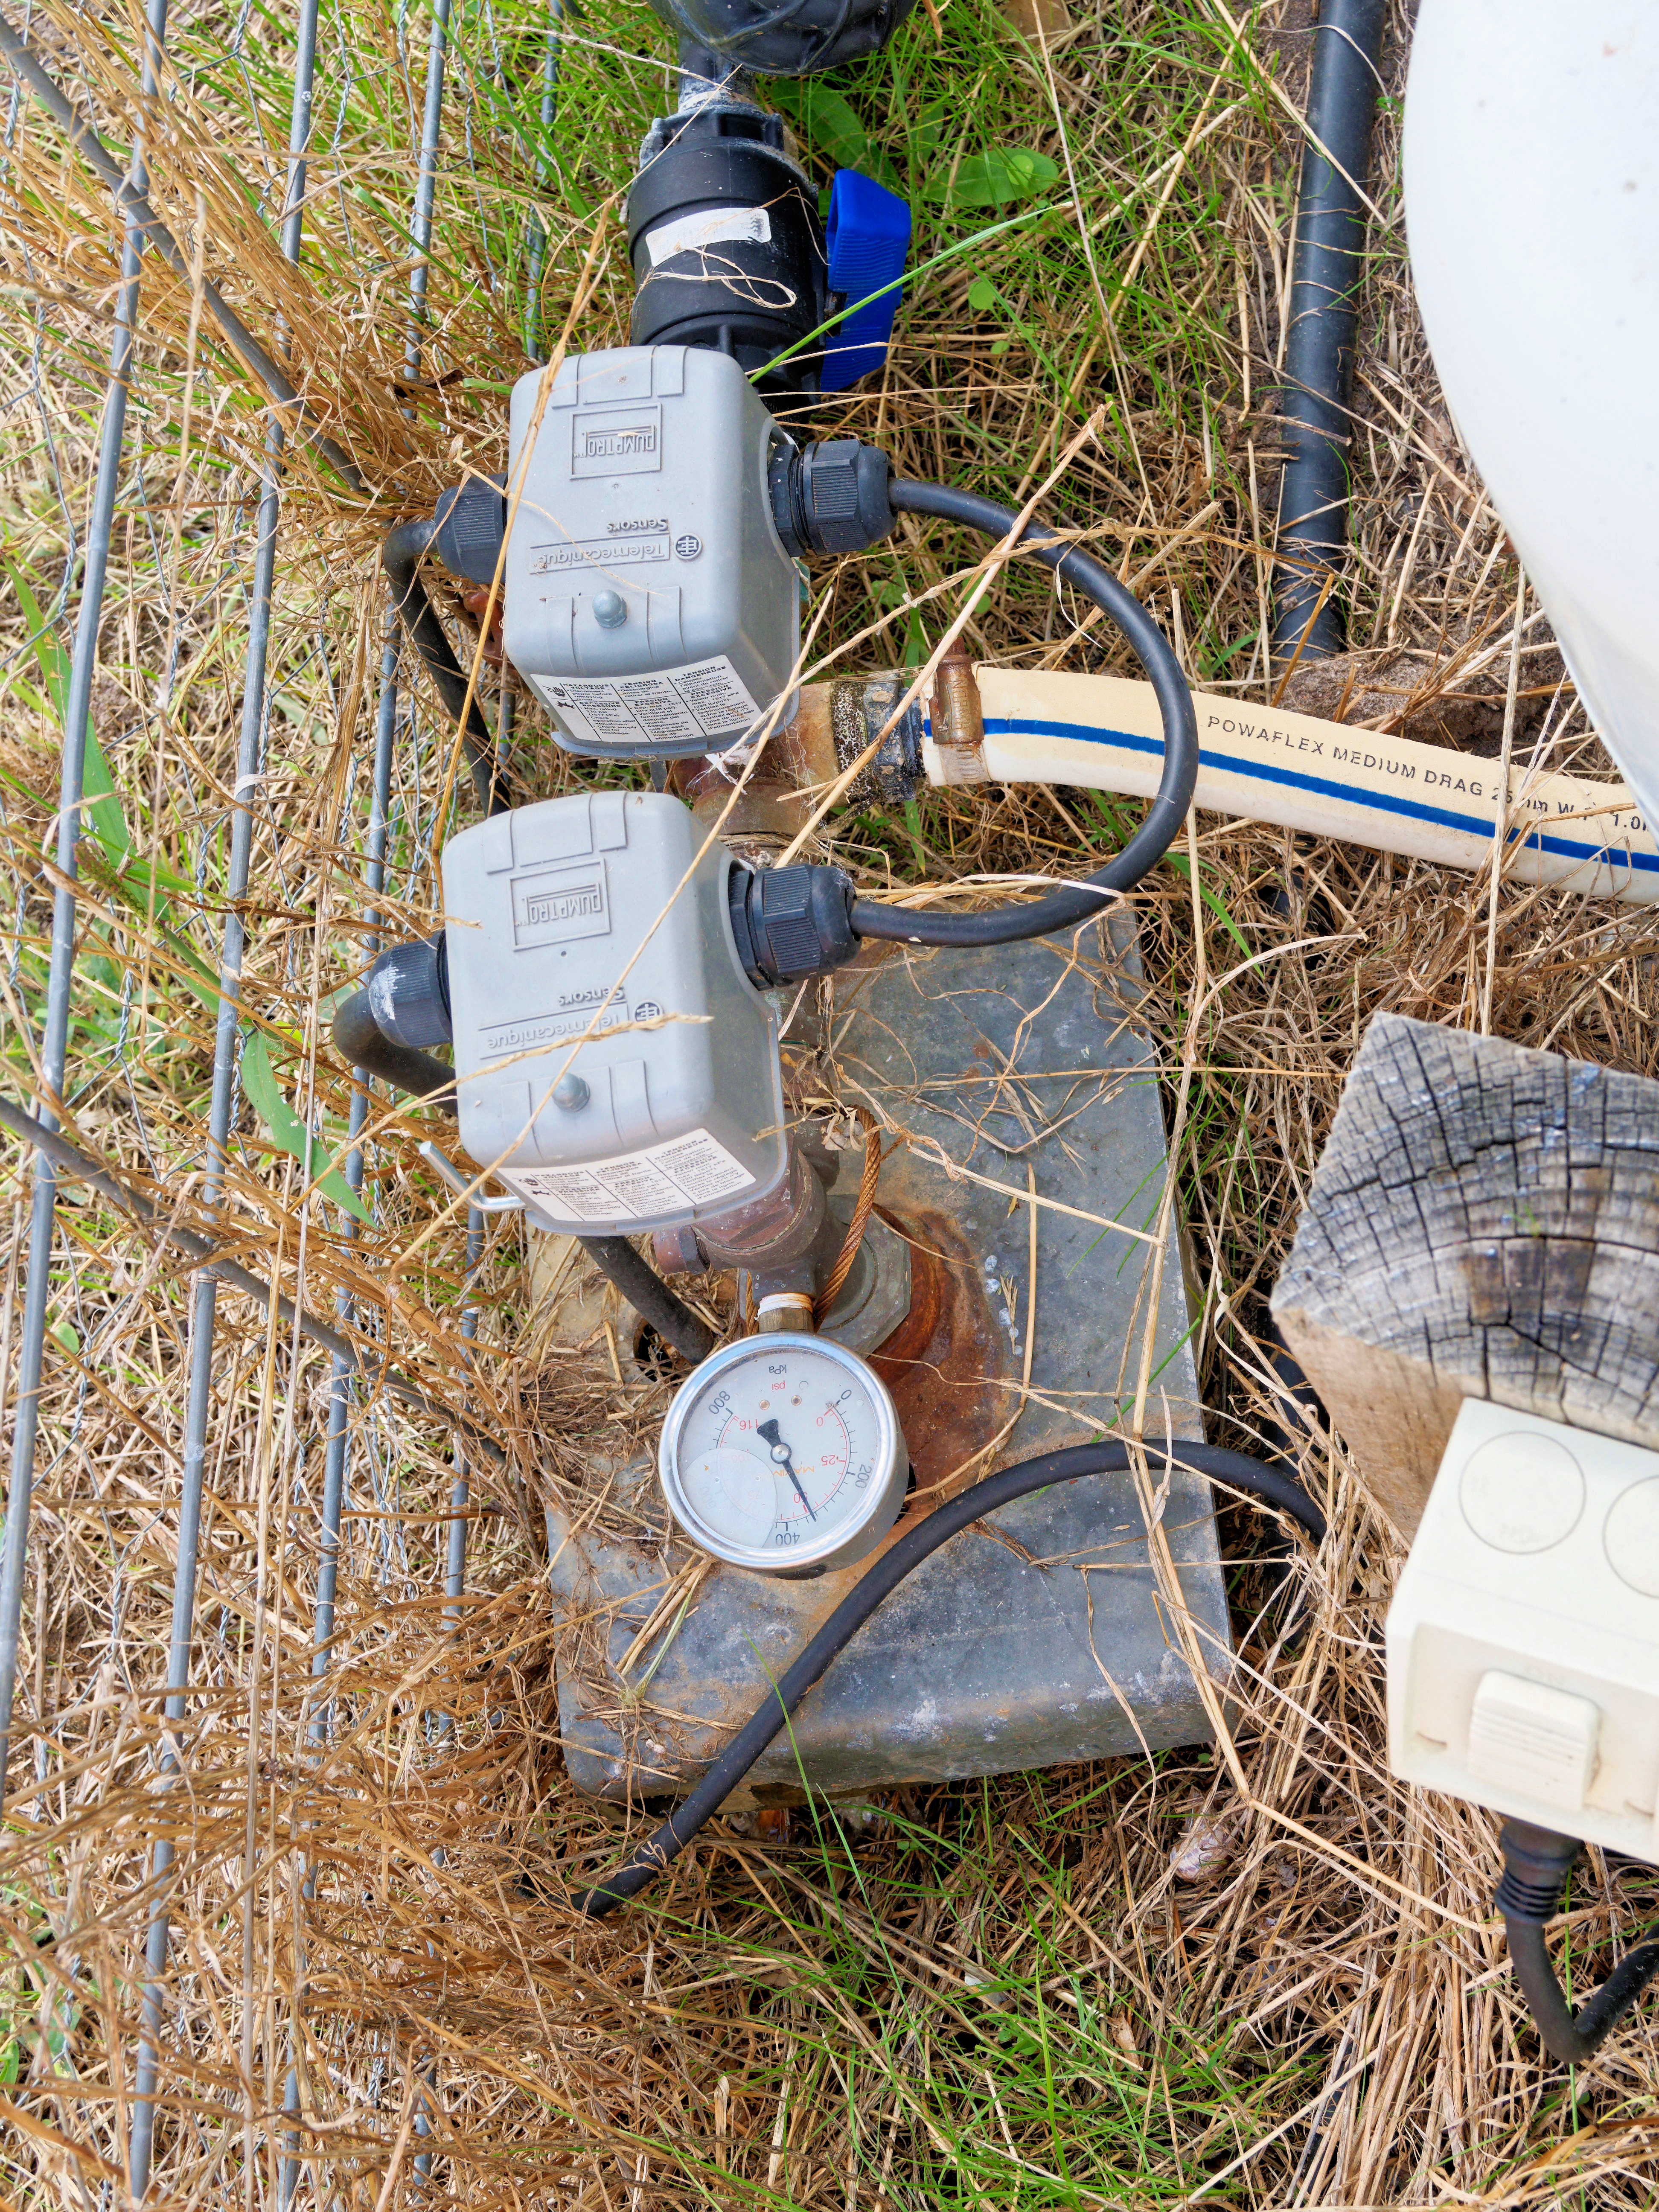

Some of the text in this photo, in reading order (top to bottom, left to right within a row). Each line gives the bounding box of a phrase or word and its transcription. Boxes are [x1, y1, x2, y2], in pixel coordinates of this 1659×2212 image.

[607, 518, 668, 533] Sensors
[537, 544, 665, 566] Telemecanique
[675, 666, 727, 682] DANGEREUSE
[682, 666, 716, 677] TENSION
[690, 684, 729, 696] PRESSION
[690, 686, 732, 699] EXCESSIVE
[1208, 716, 1324, 755] POWAFLEX
[1333, 746, 1416, 779] MEDIUM
[1424, 770, 1482, 796] DRAG
[558, 987, 625, 1006] Sensors
[768, 1364, 787, 1374] kPa
[771, 1380, 786, 1392] psi
[840, 1389, 852, 1400] 0
[708, 1390, 731, 1415] 800
[739, 1418, 760, 1430] 116
[816, 1416, 824, 1426] 0
[821, 1454, 836, 1466] 25
[855, 1464, 872, 1489] 200
[775, 1532, 800, 1546] 400
